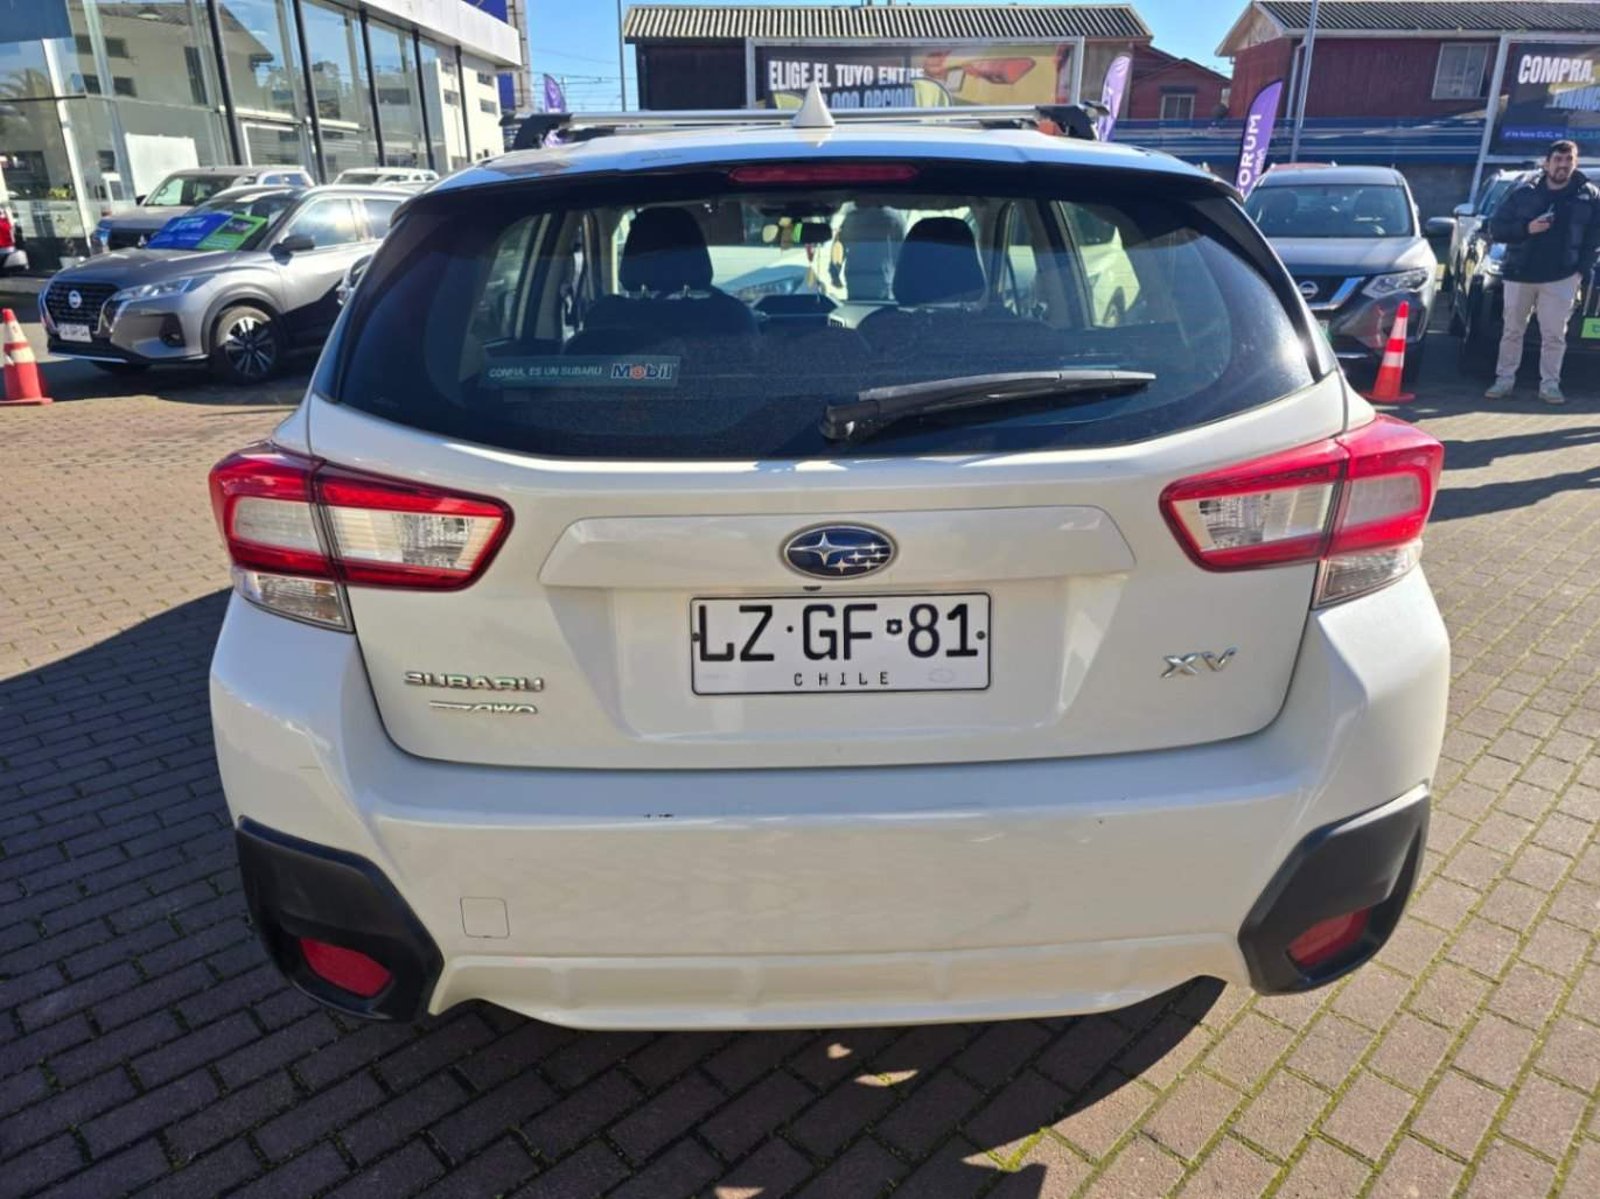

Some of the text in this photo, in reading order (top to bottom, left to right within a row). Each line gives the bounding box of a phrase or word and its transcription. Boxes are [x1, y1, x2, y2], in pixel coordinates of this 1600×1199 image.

[768, 60, 810, 91] ELIGE
[813, 62, 832, 88] EL
[835, 64, 873, 87] TUYO
[611, 363, 673, 380] Mobil
[1160, 646, 1238, 678] XV
[404, 671, 545, 692] SUBARU
[793, 671, 889, 686] CHILE
